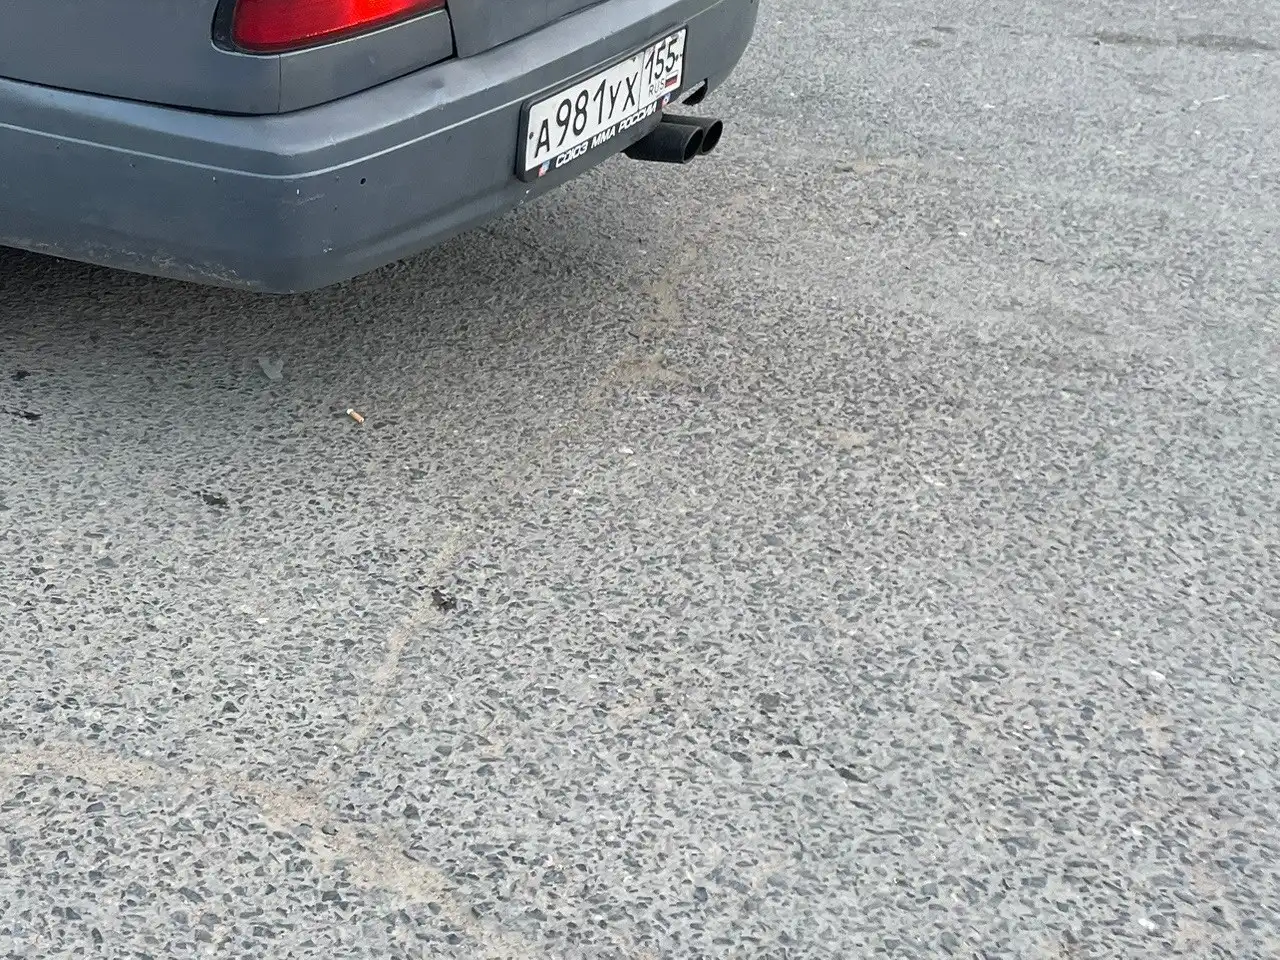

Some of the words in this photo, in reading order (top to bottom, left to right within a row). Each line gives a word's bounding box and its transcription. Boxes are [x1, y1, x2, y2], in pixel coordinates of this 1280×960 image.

[647, 78, 666, 96] RUS
[555, 141, 589, 168] СОЮЗ
[618, 101, 658, 131] РОССИИ
